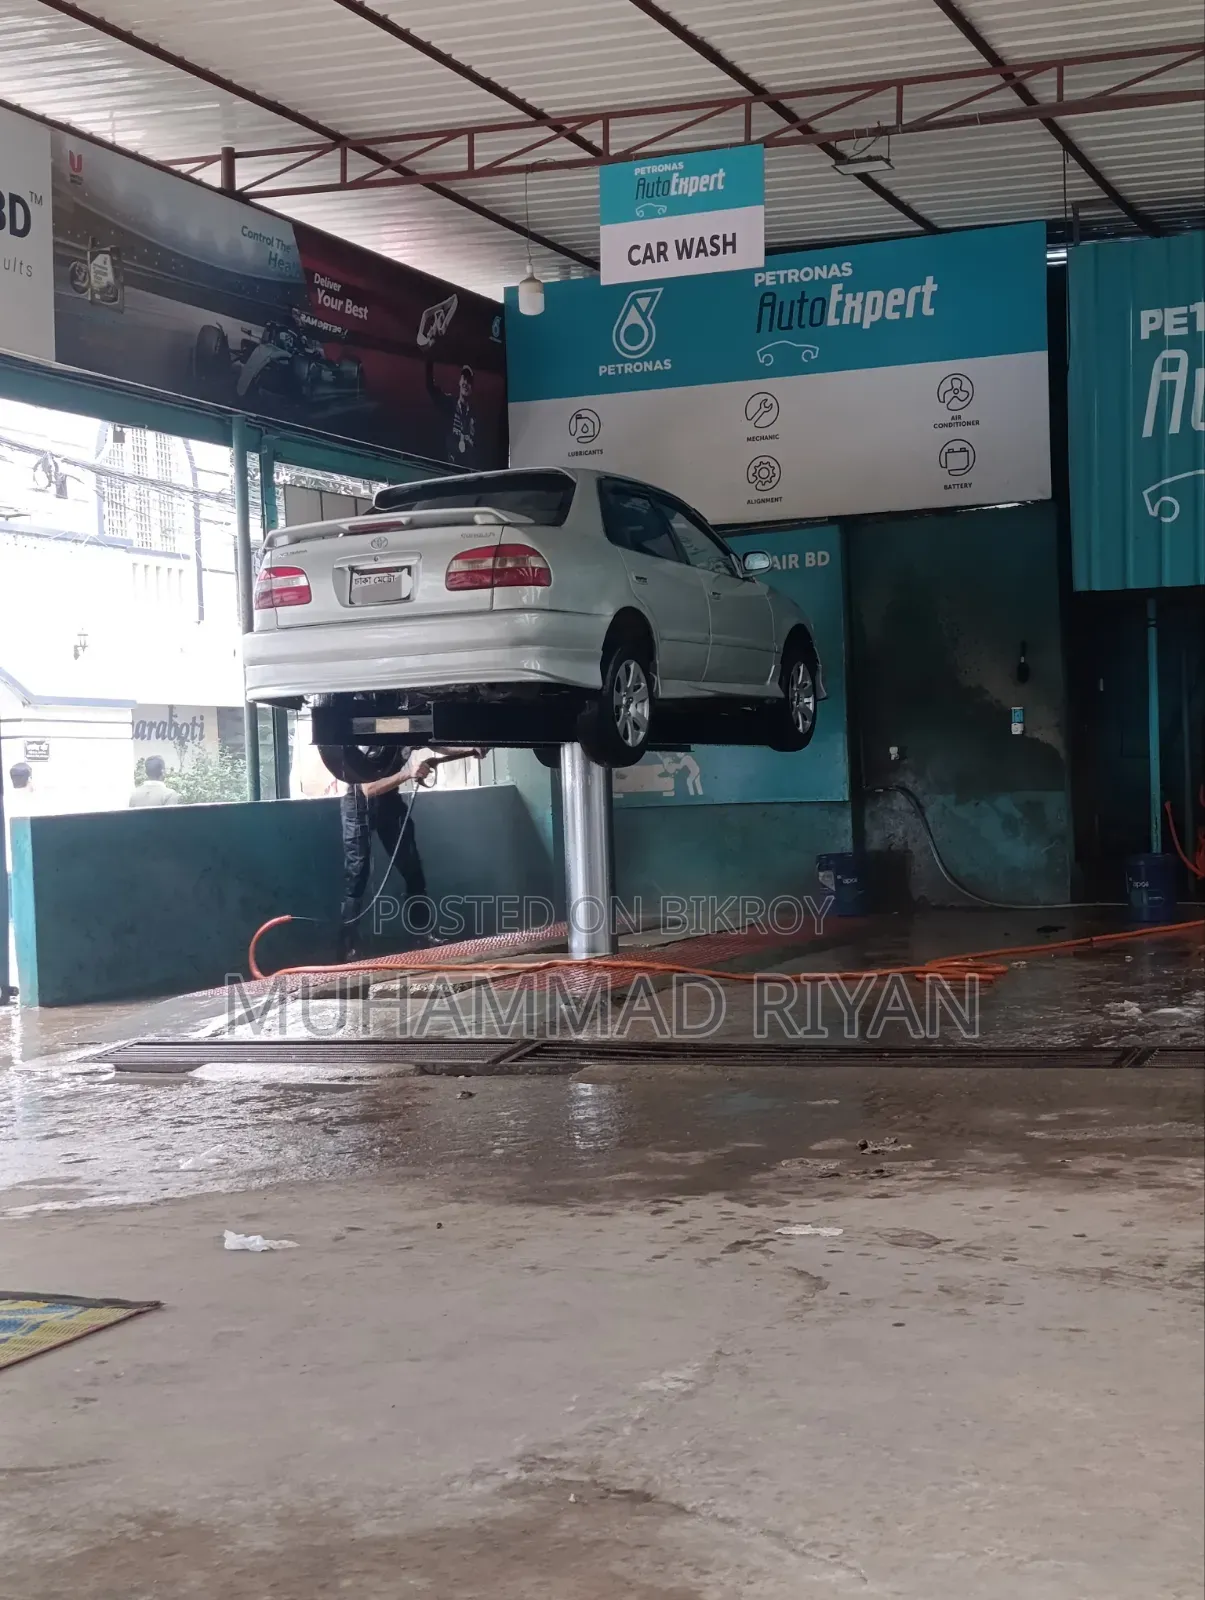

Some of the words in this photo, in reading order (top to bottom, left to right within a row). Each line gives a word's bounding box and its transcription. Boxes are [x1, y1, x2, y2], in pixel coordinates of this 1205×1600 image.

[634, 161, 684, 176] PETRONAS
[635, 168, 726, 200] AutoExpert
[241, 225, 274, 247] Control
[276, 238, 292, 253] The
[627, 240, 669, 267] CAR
[675, 232, 737, 261] WASH
[3, 257, 33, 277] ults
[754, 261, 853, 287] PETRONAS
[313, 273, 342, 292] Deliver
[317, 288, 344, 311] Your
[345, 298, 369, 320] Best
[756, 275, 939, 334] AutoExpert
[1141, 301, 1205, 340] PET
[598, 358, 672, 376] PETRONAS
[933, 420, 980, 429] CONDITIONER
[746, 434, 780, 442] MECHANIC
[568, 449, 604, 457] LUBRICANTS
[943, 482, 973, 490] BATTERY
[746, 496, 783, 505] ALIGNMENT
[805, 551, 830, 568] BD
[354, 577, 372, 585] ঢাকা
